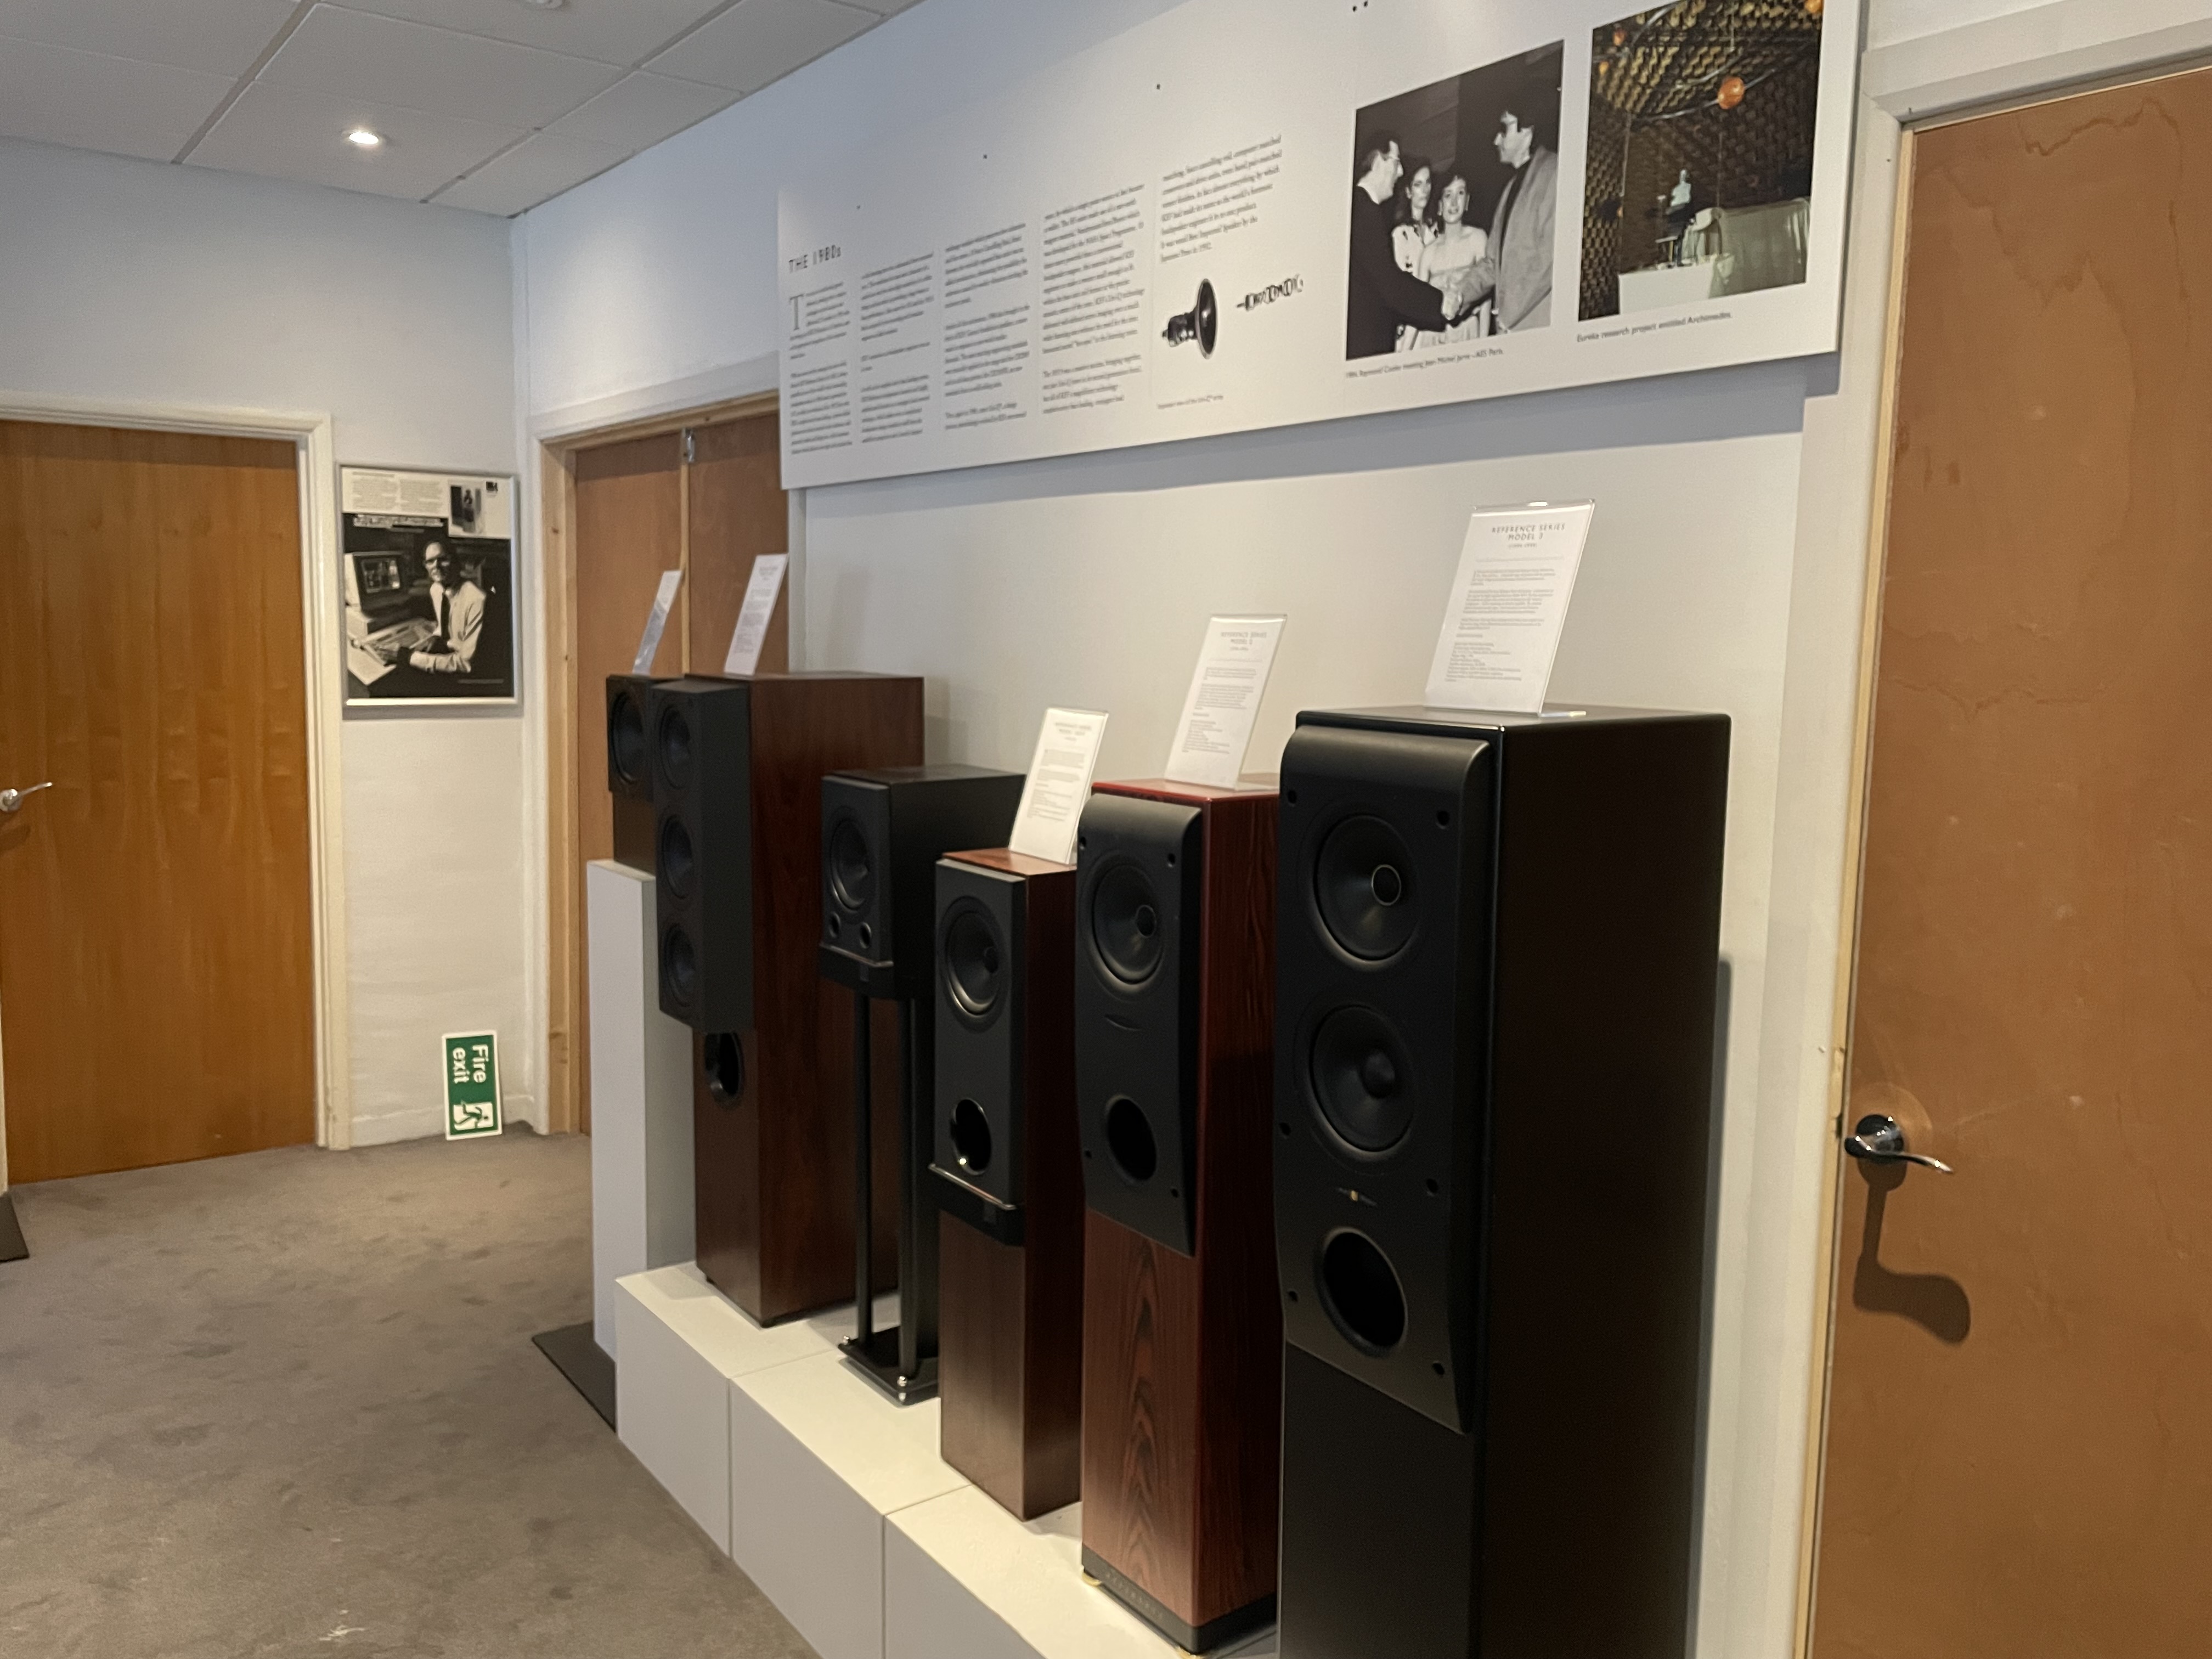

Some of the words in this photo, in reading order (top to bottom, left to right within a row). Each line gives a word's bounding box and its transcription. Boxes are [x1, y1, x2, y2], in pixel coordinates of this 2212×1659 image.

[789, 254, 808, 273] THE
[812, 245, 841, 265] 1980s
[1491, 524, 1536, 534] REFERENCE
[1539, 523, 1566, 532] SERIES
[1508, 533, 1534, 541] MODEL
[453, 1047, 470, 1084] exit
[472, 1044, 489, 1084] Fire
